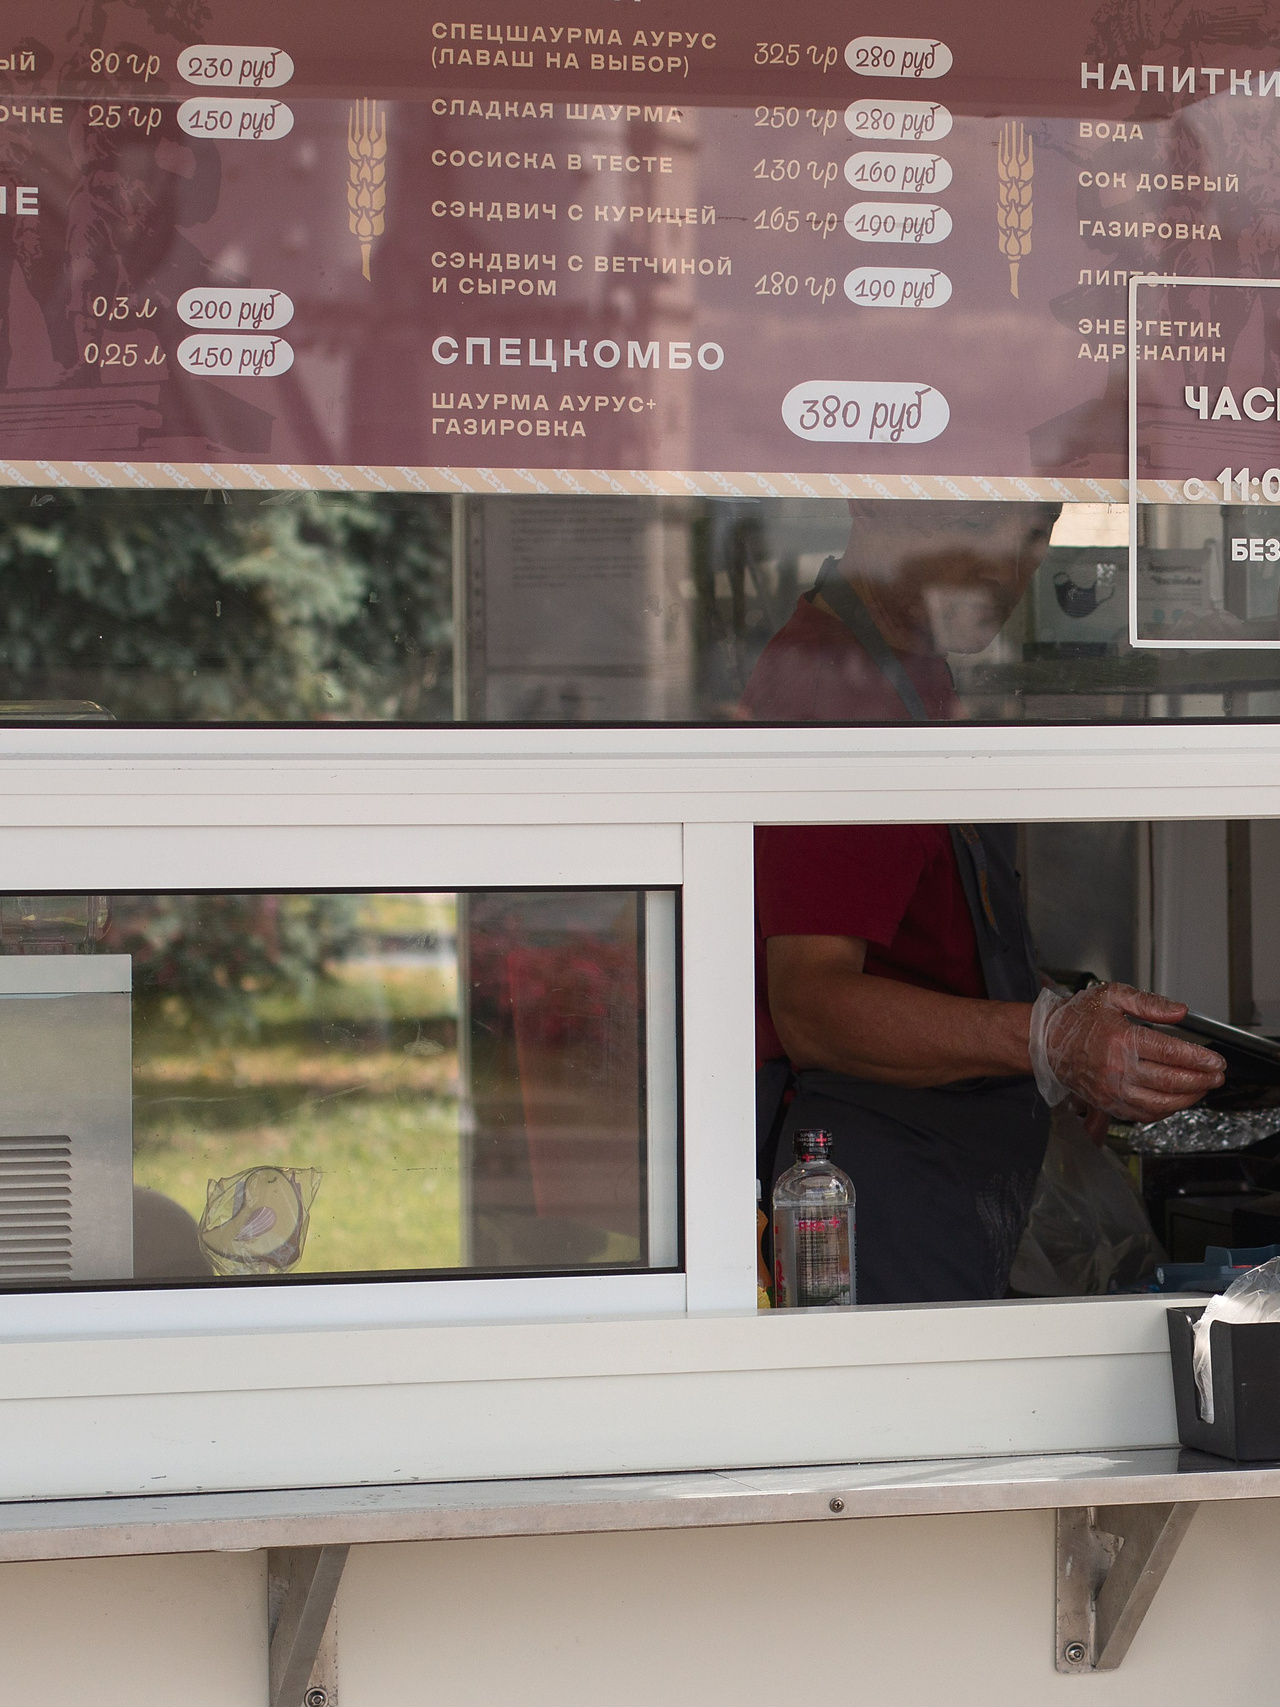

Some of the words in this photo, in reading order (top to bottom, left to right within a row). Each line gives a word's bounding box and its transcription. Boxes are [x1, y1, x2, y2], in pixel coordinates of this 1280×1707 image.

[432, 22, 625, 49] СПЕЦШАУРМА
[632, 29, 717, 50] АУРУС
[90, 49, 119, 74] 80
[126, 54, 161, 83] гр
[188, 57, 233, 77] 230
[239, 50, 283, 87] руб
[432, 48, 537, 70] (ЛАВАШ
[545, 51, 580, 70] НА
[590, 53, 690, 78] ВЫБОР)
[753, 43, 800, 66] 325
[807, 46, 838, 74] гр
[855, 46, 896, 68] 280
[900, 42, 942, 77] руб
[89, 104, 121, 129] 25
[128, 107, 162, 136] гр
[189, 110, 233, 131] 150
[239, 102, 282, 139] руб
[432, 99, 555, 121] СЛАДКАЯ
[565, 101, 682, 123] ШАУРМА
[754, 105, 800, 129] 250
[806, 108, 838, 136] гр
[855, 108, 896, 131] 280
[900, 105, 942, 140] руб
[1079, 122, 1144, 142] ВОДА
[432, 149, 556, 171] СОСИСКА
[567, 153, 582, 171] В
[592, 153, 673, 174] ТЕСТЕ
[753, 158, 800, 181] 130
[806, 162, 838, 189] гр
[854, 161, 896, 184] 160
[900, 157, 942, 192] руб
[1078, 171, 1126, 188] СОК
[1137, 172, 1240, 193] ДОБРЫЙ
[432, 200, 557, 223] СЭНДВИЧ
[568, 203, 585, 222] С
[594, 202, 717, 229] КУРИЦЕЙ
[753, 206, 800, 233] 165
[806, 212, 838, 240] гр
[854, 214, 896, 236] 190
[900, 207, 942, 243] руб
[1079, 220, 1222, 241] ГАЗИРОВКА
[432, 250, 557, 274] СЭНДВИЧ
[568, 253, 585, 272] С
[594, 254, 733, 277] ВЕТЧИНОЙ
[432, 276, 448, 295] И
[456, 276, 557, 297] СЫРОМ
[755, 271, 798, 296] 180
[804, 276, 837, 304] гр
[854, 279, 896, 301] 190
[900, 271, 942, 307] руб
[92, 296, 129, 321] 0,3
[135, 298, 157, 318] л
[189, 300, 232, 320] 200
[237, 292, 281, 328] руб
[84, 343, 138, 368] 0,25
[145, 346, 166, 365] л
[189, 347, 233, 368] 150
[238, 339, 282, 376] руб
[432, 335, 726, 373] СПЕЦКОМБО
[432, 391, 550, 412] ШАУРМА
[558, 394, 658, 414] АУРУС+
[799, 394, 861, 430] 380
[869, 387, 932, 442] руб
[432, 416, 587, 438] ГАЗИРОВКА
[1231, 538, 1280, 562] БЕЗ
